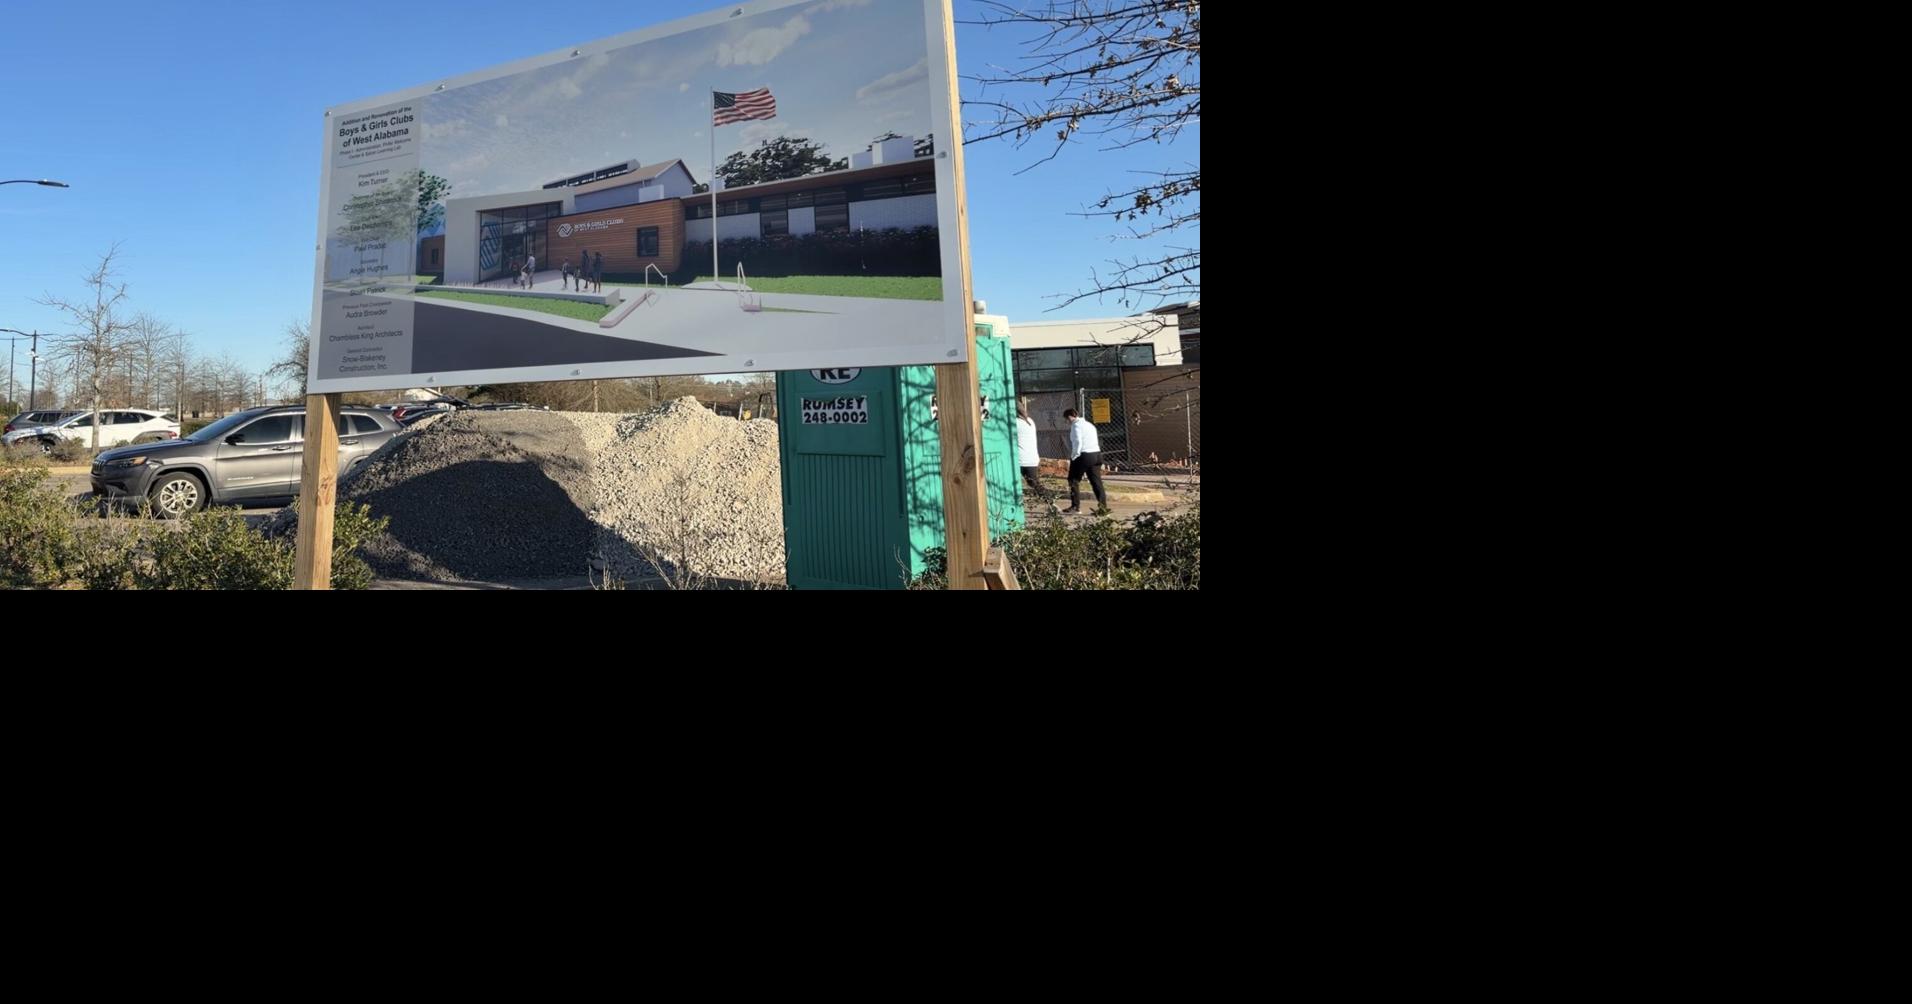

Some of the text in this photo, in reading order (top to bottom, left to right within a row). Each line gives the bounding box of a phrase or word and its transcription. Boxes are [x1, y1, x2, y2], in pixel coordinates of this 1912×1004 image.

[371, 111, 398, 119] Renovation
[339, 115, 413, 137] Boys & Girls Clubs
[343, 138, 351, 147] of
[352, 134, 373, 145] West
[374, 128, 409, 141] Alabama
[360, 332, 375, 341] King
[375, 330, 403, 338] Architects
[803, 397, 865, 410] RUMSEY
[804, 412, 867, 424] 248-0002
